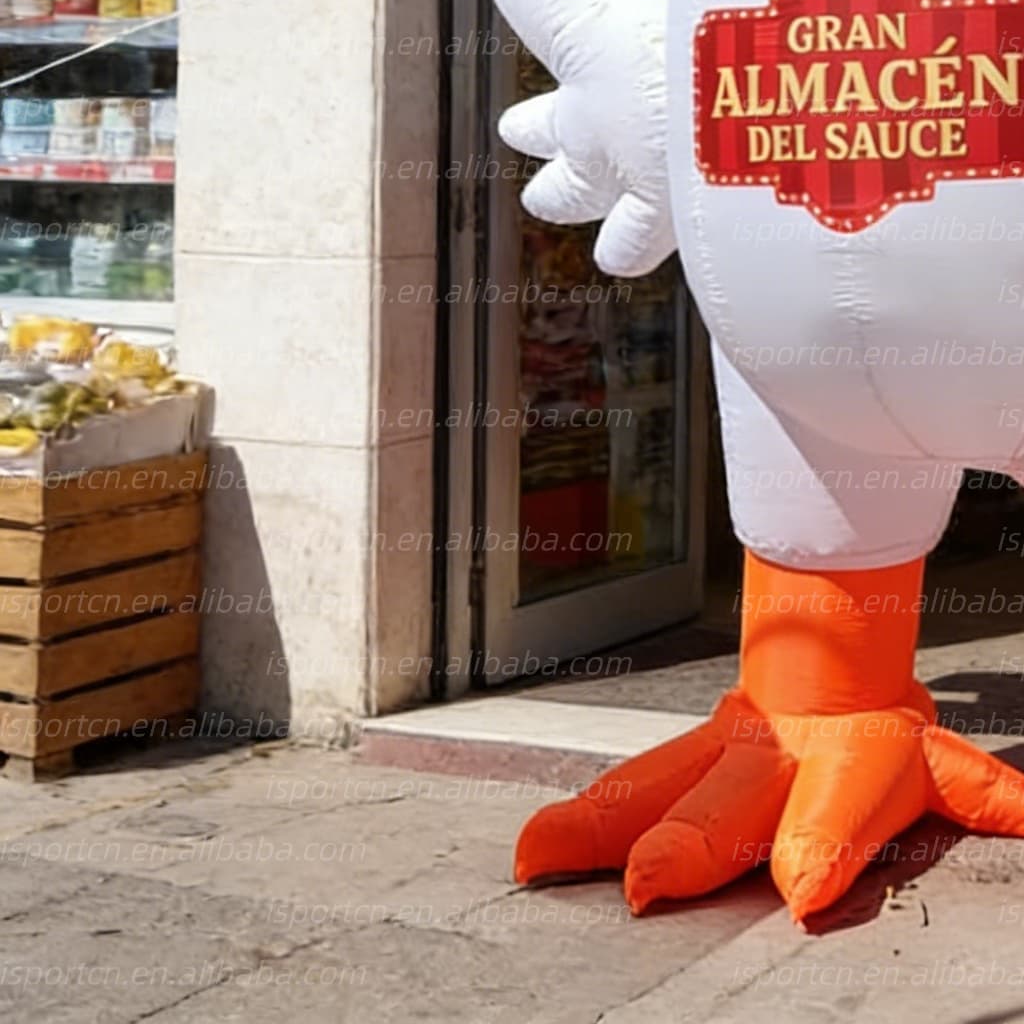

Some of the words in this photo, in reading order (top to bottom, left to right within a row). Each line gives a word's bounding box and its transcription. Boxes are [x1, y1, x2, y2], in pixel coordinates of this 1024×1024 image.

[787, 12, 908, 54] GRAN
[711, 36, 1024, 119] ALMACÉN
[747, 124, 817, 163] DEL
[824, 117, 968, 160] SAUCE
